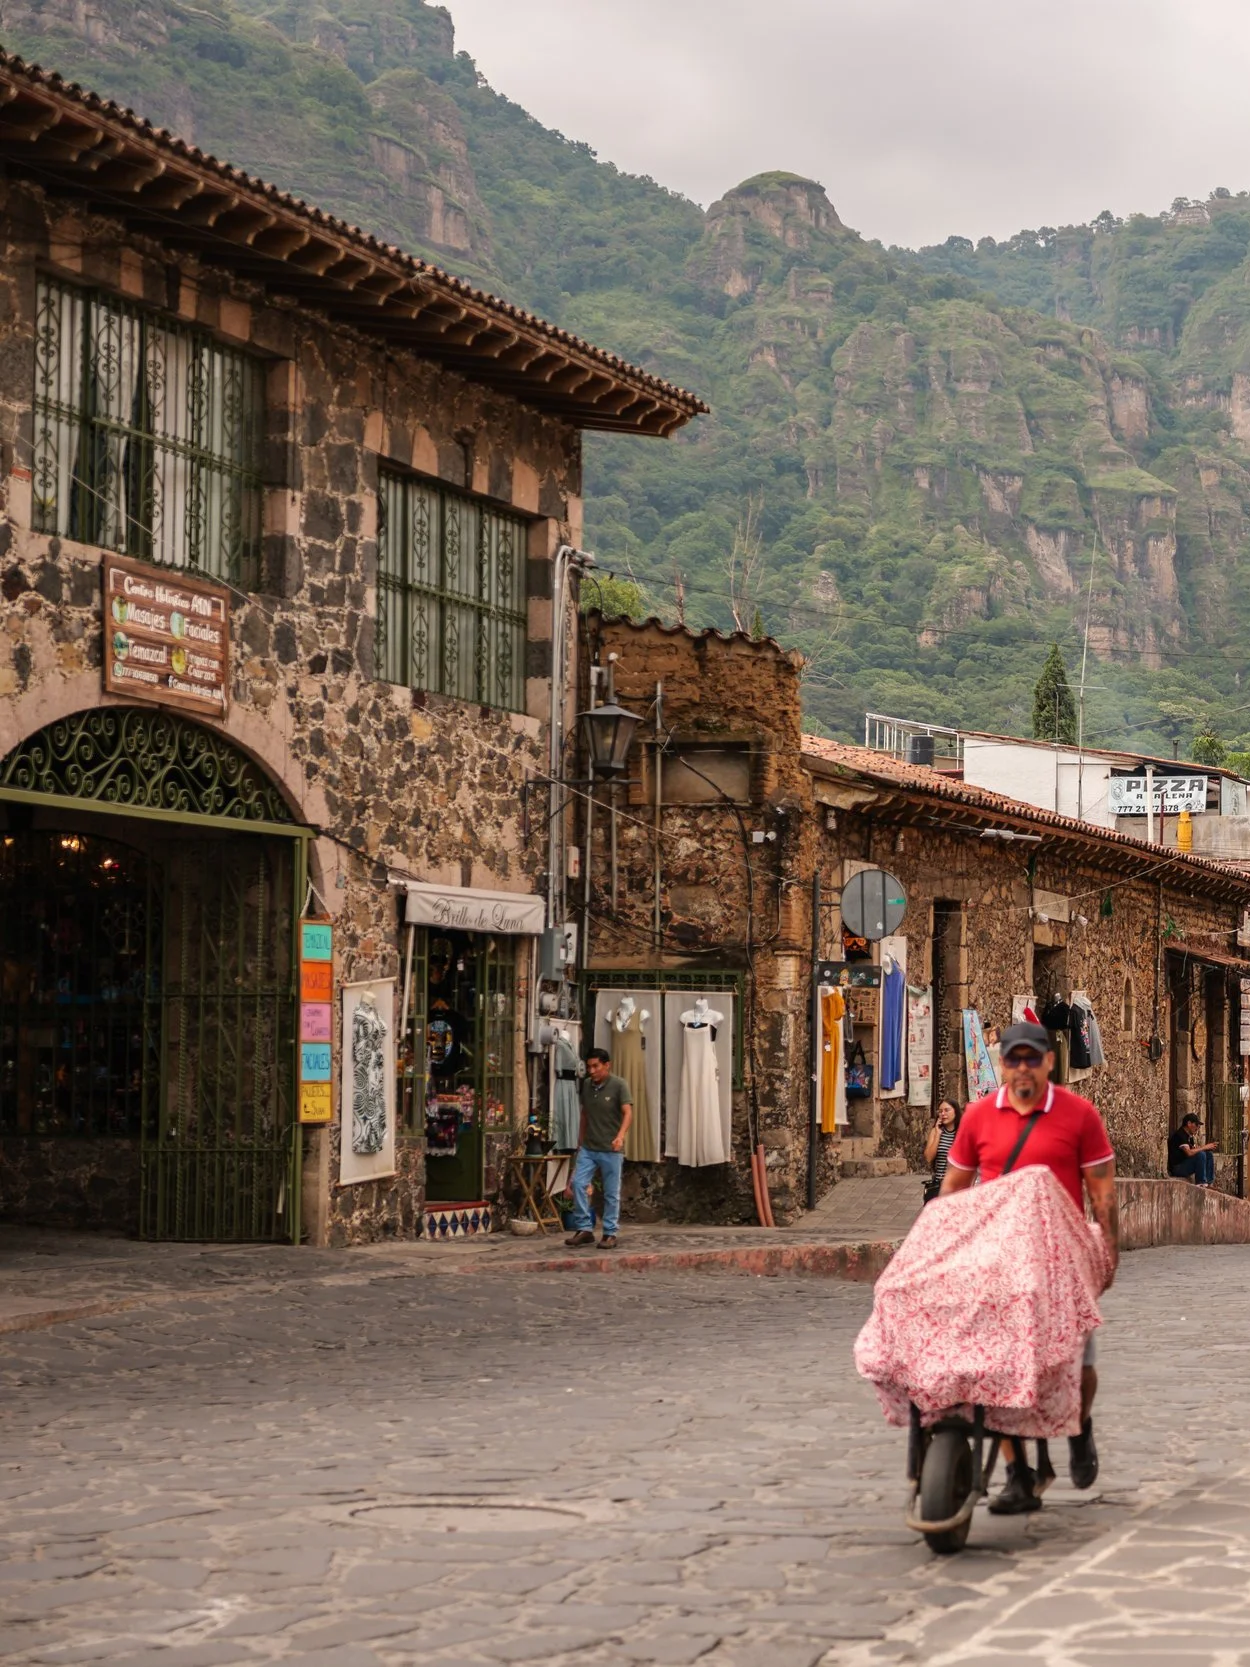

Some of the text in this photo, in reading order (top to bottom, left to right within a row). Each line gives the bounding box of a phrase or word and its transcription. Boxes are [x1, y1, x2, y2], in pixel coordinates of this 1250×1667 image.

[127, 602, 166, 632] Masajes
[183, 617, 221, 644] Faciales
[127, 638, 168, 664] Temazcal
[1126, 779, 1204, 792] PIZZA
[432, 897, 524, 931] Brillo de Luna
